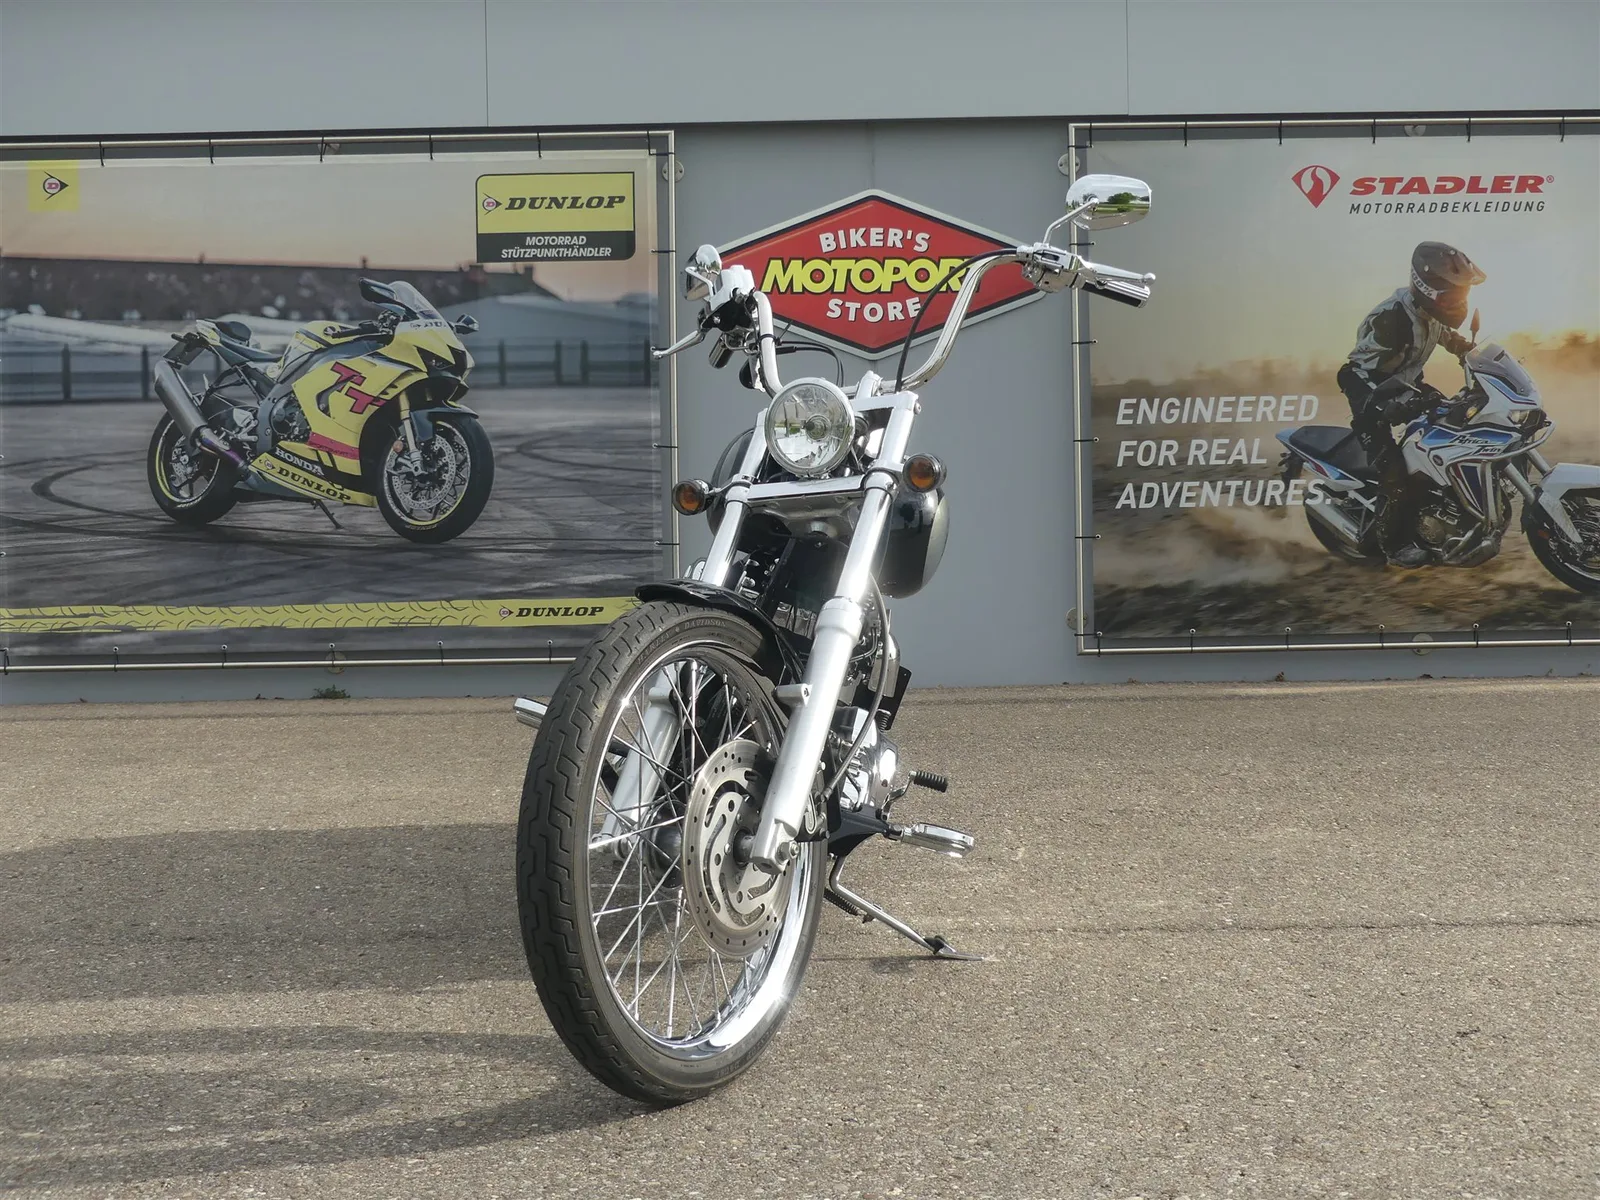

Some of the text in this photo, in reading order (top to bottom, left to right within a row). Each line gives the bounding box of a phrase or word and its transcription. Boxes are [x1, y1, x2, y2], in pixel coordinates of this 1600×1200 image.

[504, 195, 626, 211] DUNLOP
[1349, 200, 1546, 215] MOTORRADBEKLEIDUNG
[501, 246, 612, 259] STÜTZPUNKTHÄNDLER
[525, 235, 587, 247] MOTORRAD
[818, 227, 931, 254] BIKER'S
[826, 296, 922, 323] STORE
[1115, 395, 1320, 426] ENGINEERED
[275, 446, 326, 476] HONDA
[1116, 437, 1269, 468] FOR REAL
[277, 466, 352, 502] DUNLOP
[1114, 478, 1333, 510] ADVENTURES.
[515, 606, 605, 618] DUNLOP
